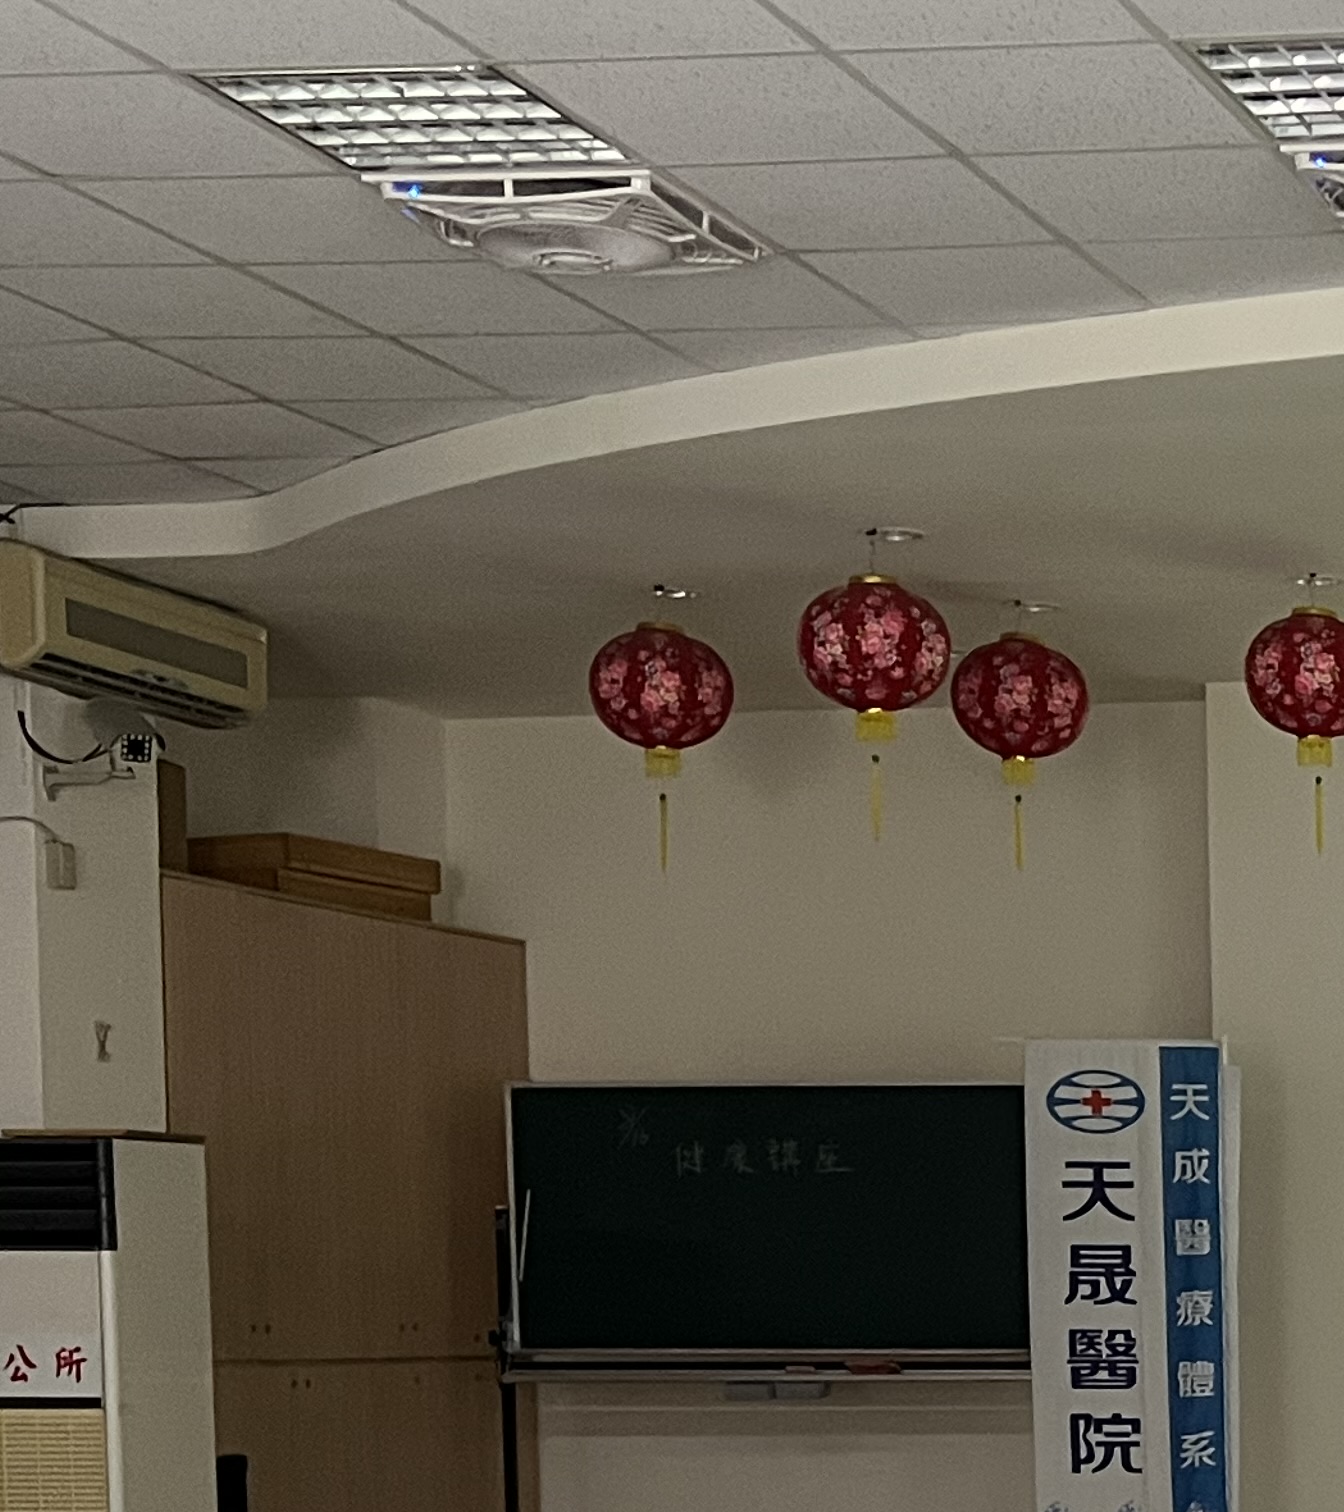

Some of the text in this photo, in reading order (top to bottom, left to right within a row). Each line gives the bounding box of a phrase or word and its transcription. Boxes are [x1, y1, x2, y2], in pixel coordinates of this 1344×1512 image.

[3, 1344, 88, 1383] 公所
[1062, 1161, 1142, 1475] 天晟醫院
[1170, 1083, 1216, 1469] 天成醫療體系
